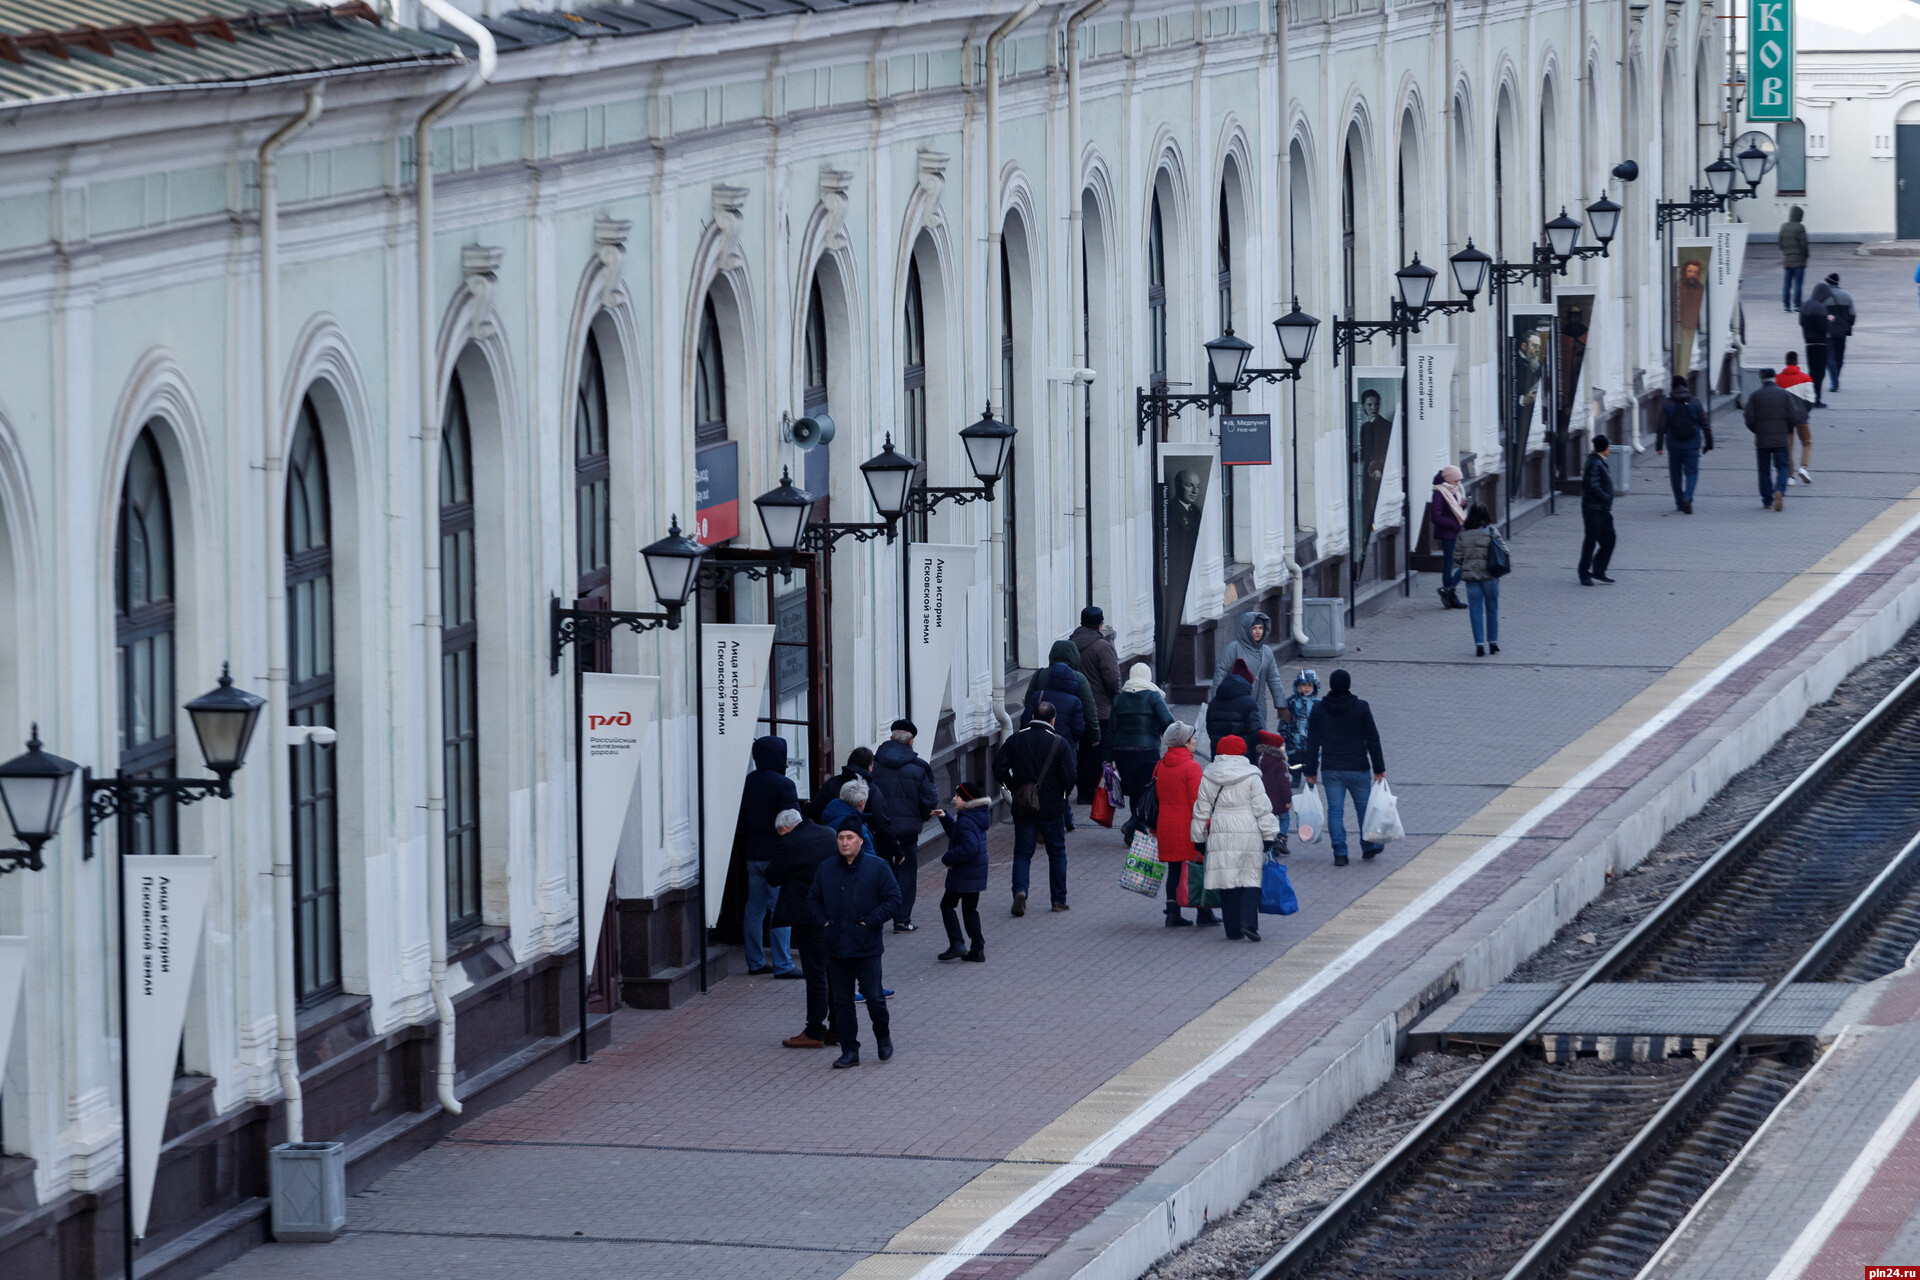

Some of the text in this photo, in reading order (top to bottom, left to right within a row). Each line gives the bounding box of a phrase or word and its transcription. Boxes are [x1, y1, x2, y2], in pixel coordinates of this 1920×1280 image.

[1426, 355, 1434, 408] Лица истории
[923, 558, 932, 611] Псковской
[934, 558, 945, 628] Лица истории
[717, 641, 727, 699] Псковской
[729, 640, 740, 717] Лица истории
[590, 736, 637, 744] Российские
[1137, 861, 1154, 875] FIX
[142, 876, 155, 996] Псковской земли
[157, 875, 171, 973] Лица истории
